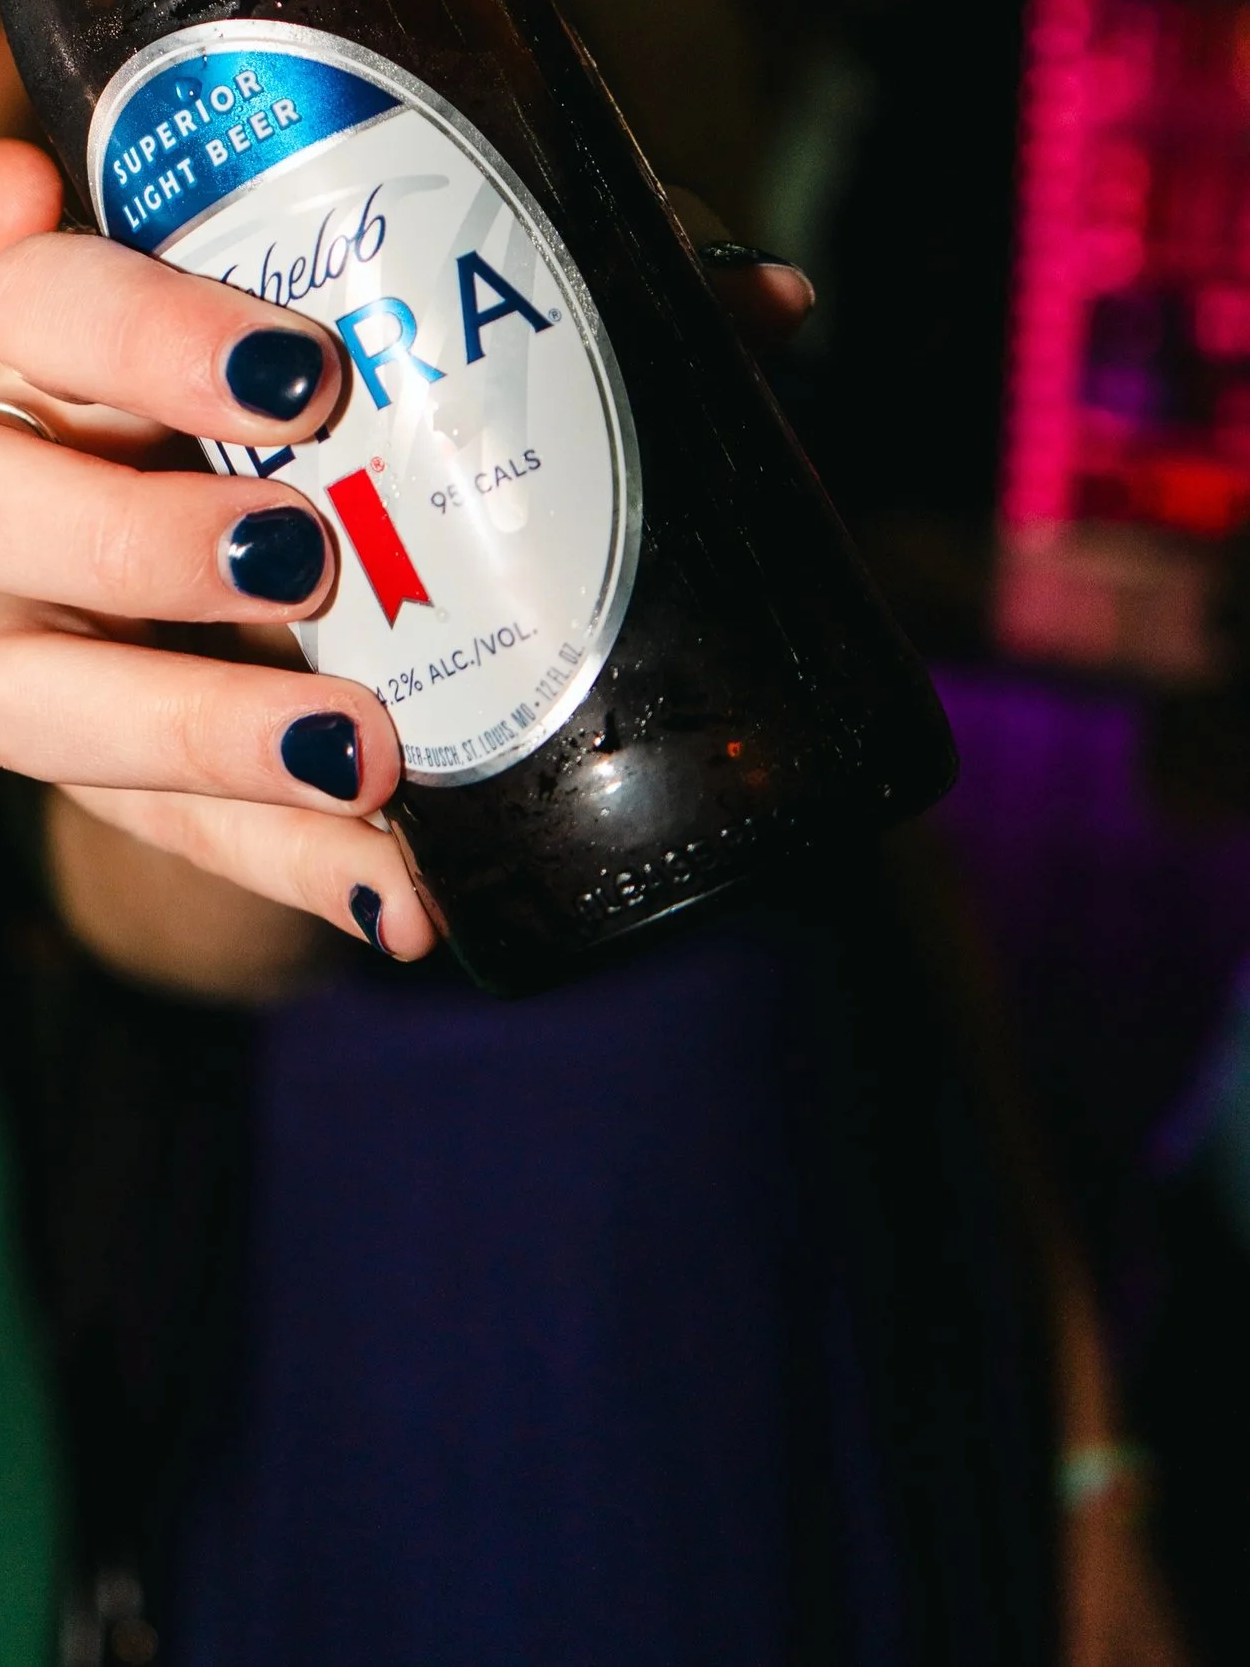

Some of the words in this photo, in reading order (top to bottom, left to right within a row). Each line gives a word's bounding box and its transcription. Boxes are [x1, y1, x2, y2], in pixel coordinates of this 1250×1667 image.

[111, 68, 264, 187] SUPERIOR
[121, 157, 198, 231] LIGHT
[207, 97, 301, 167] BEER
[220, 184, 387, 310] helob
[430, 484, 464, 516] 95
[474, 448, 543, 495] CALS
[428, 621, 540, 686] ALC./VOL.
